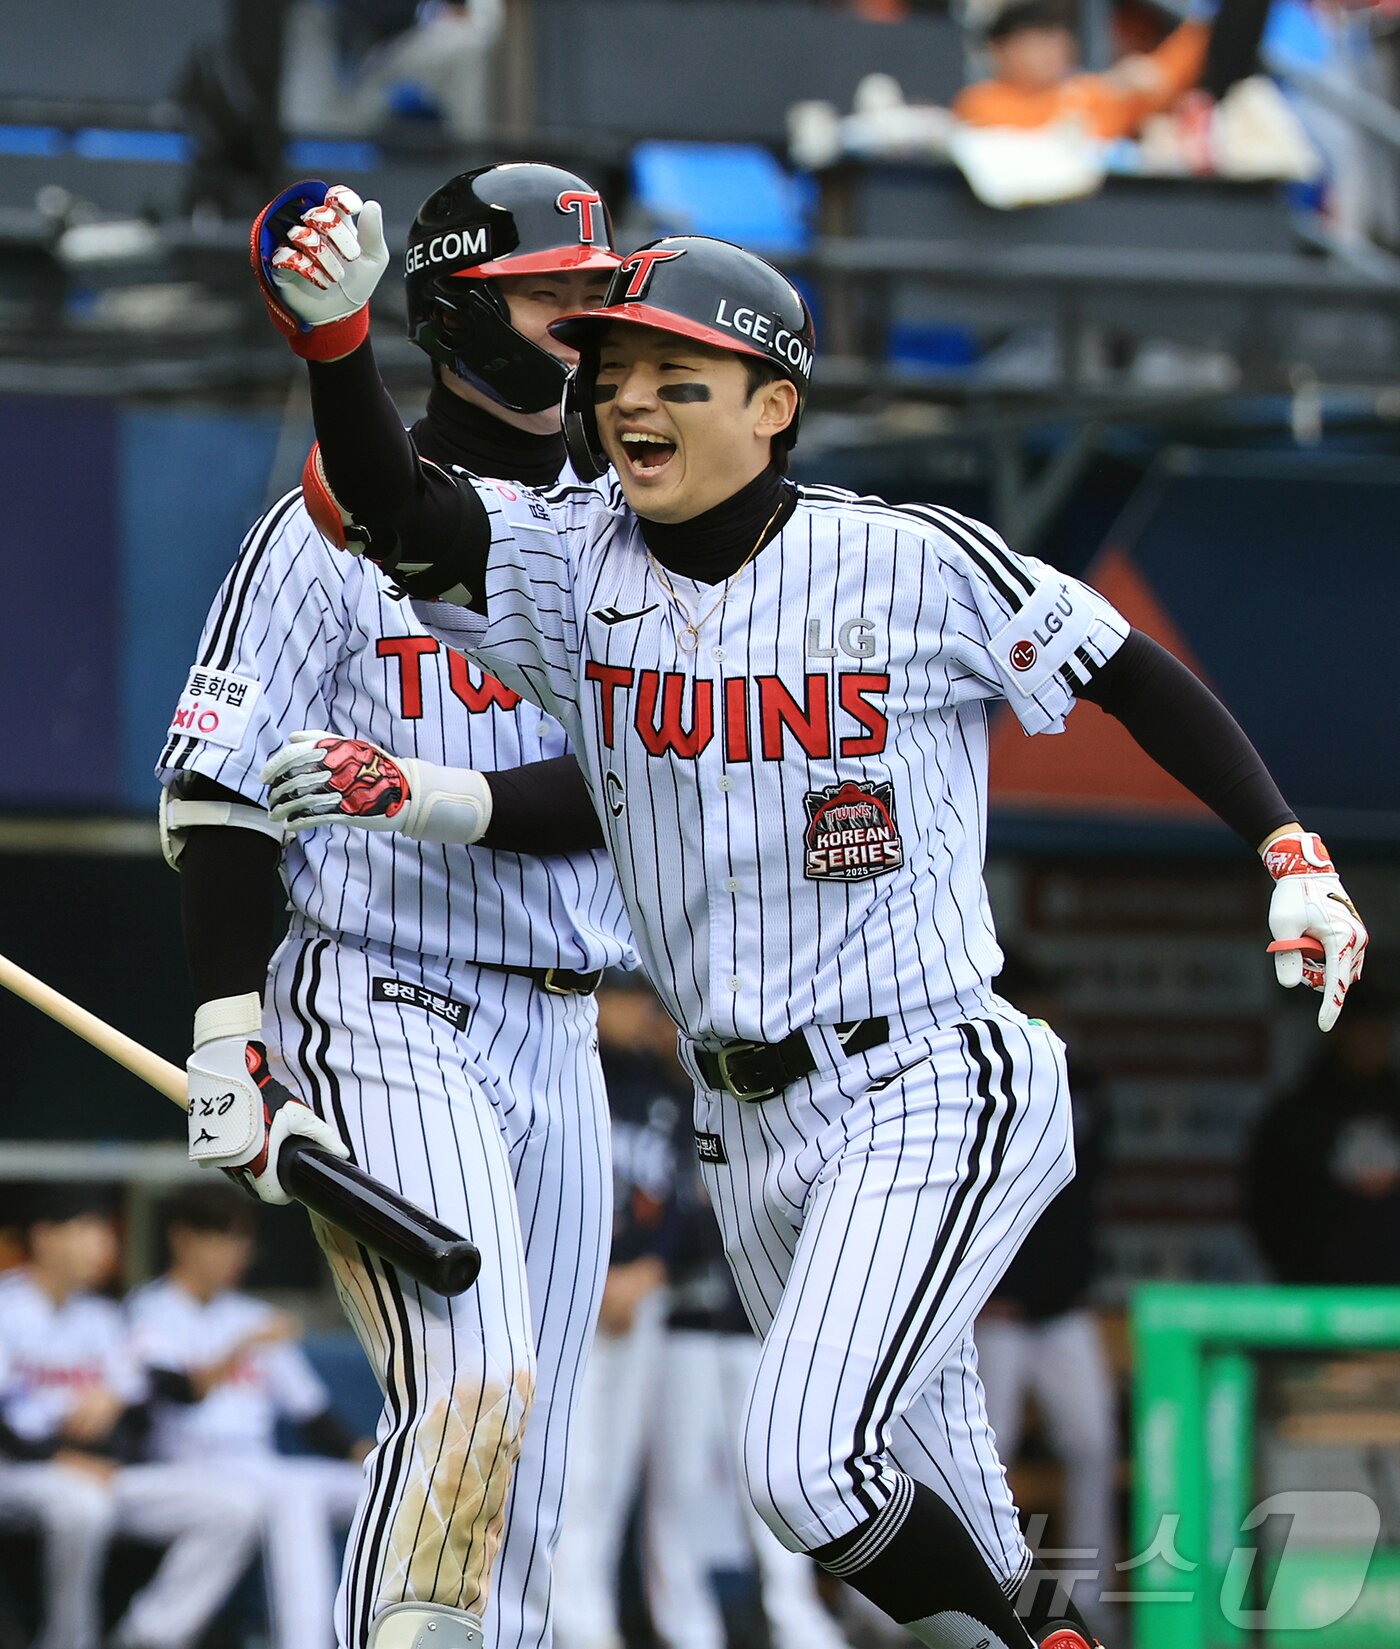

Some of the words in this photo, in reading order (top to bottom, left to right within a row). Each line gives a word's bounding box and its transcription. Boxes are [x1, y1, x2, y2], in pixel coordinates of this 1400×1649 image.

[404, 228, 487, 277] GE.COM
[715, 299, 814, 379] LGE.COM
[807, 618, 876, 658] LG
[190, 673, 248, 707] 통화앱
[585, 660, 890, 763] TWINS
[606, 769, 626, 818] C
[826, 804, 872, 822] TWINS
[817, 826, 890, 848] KOREAN
[808, 840, 900, 874] SERIES
[846, 867, 868, 877] 2025
[382, 982, 415, 1001] 영진
[418, 990, 462, 1021] 구론산
